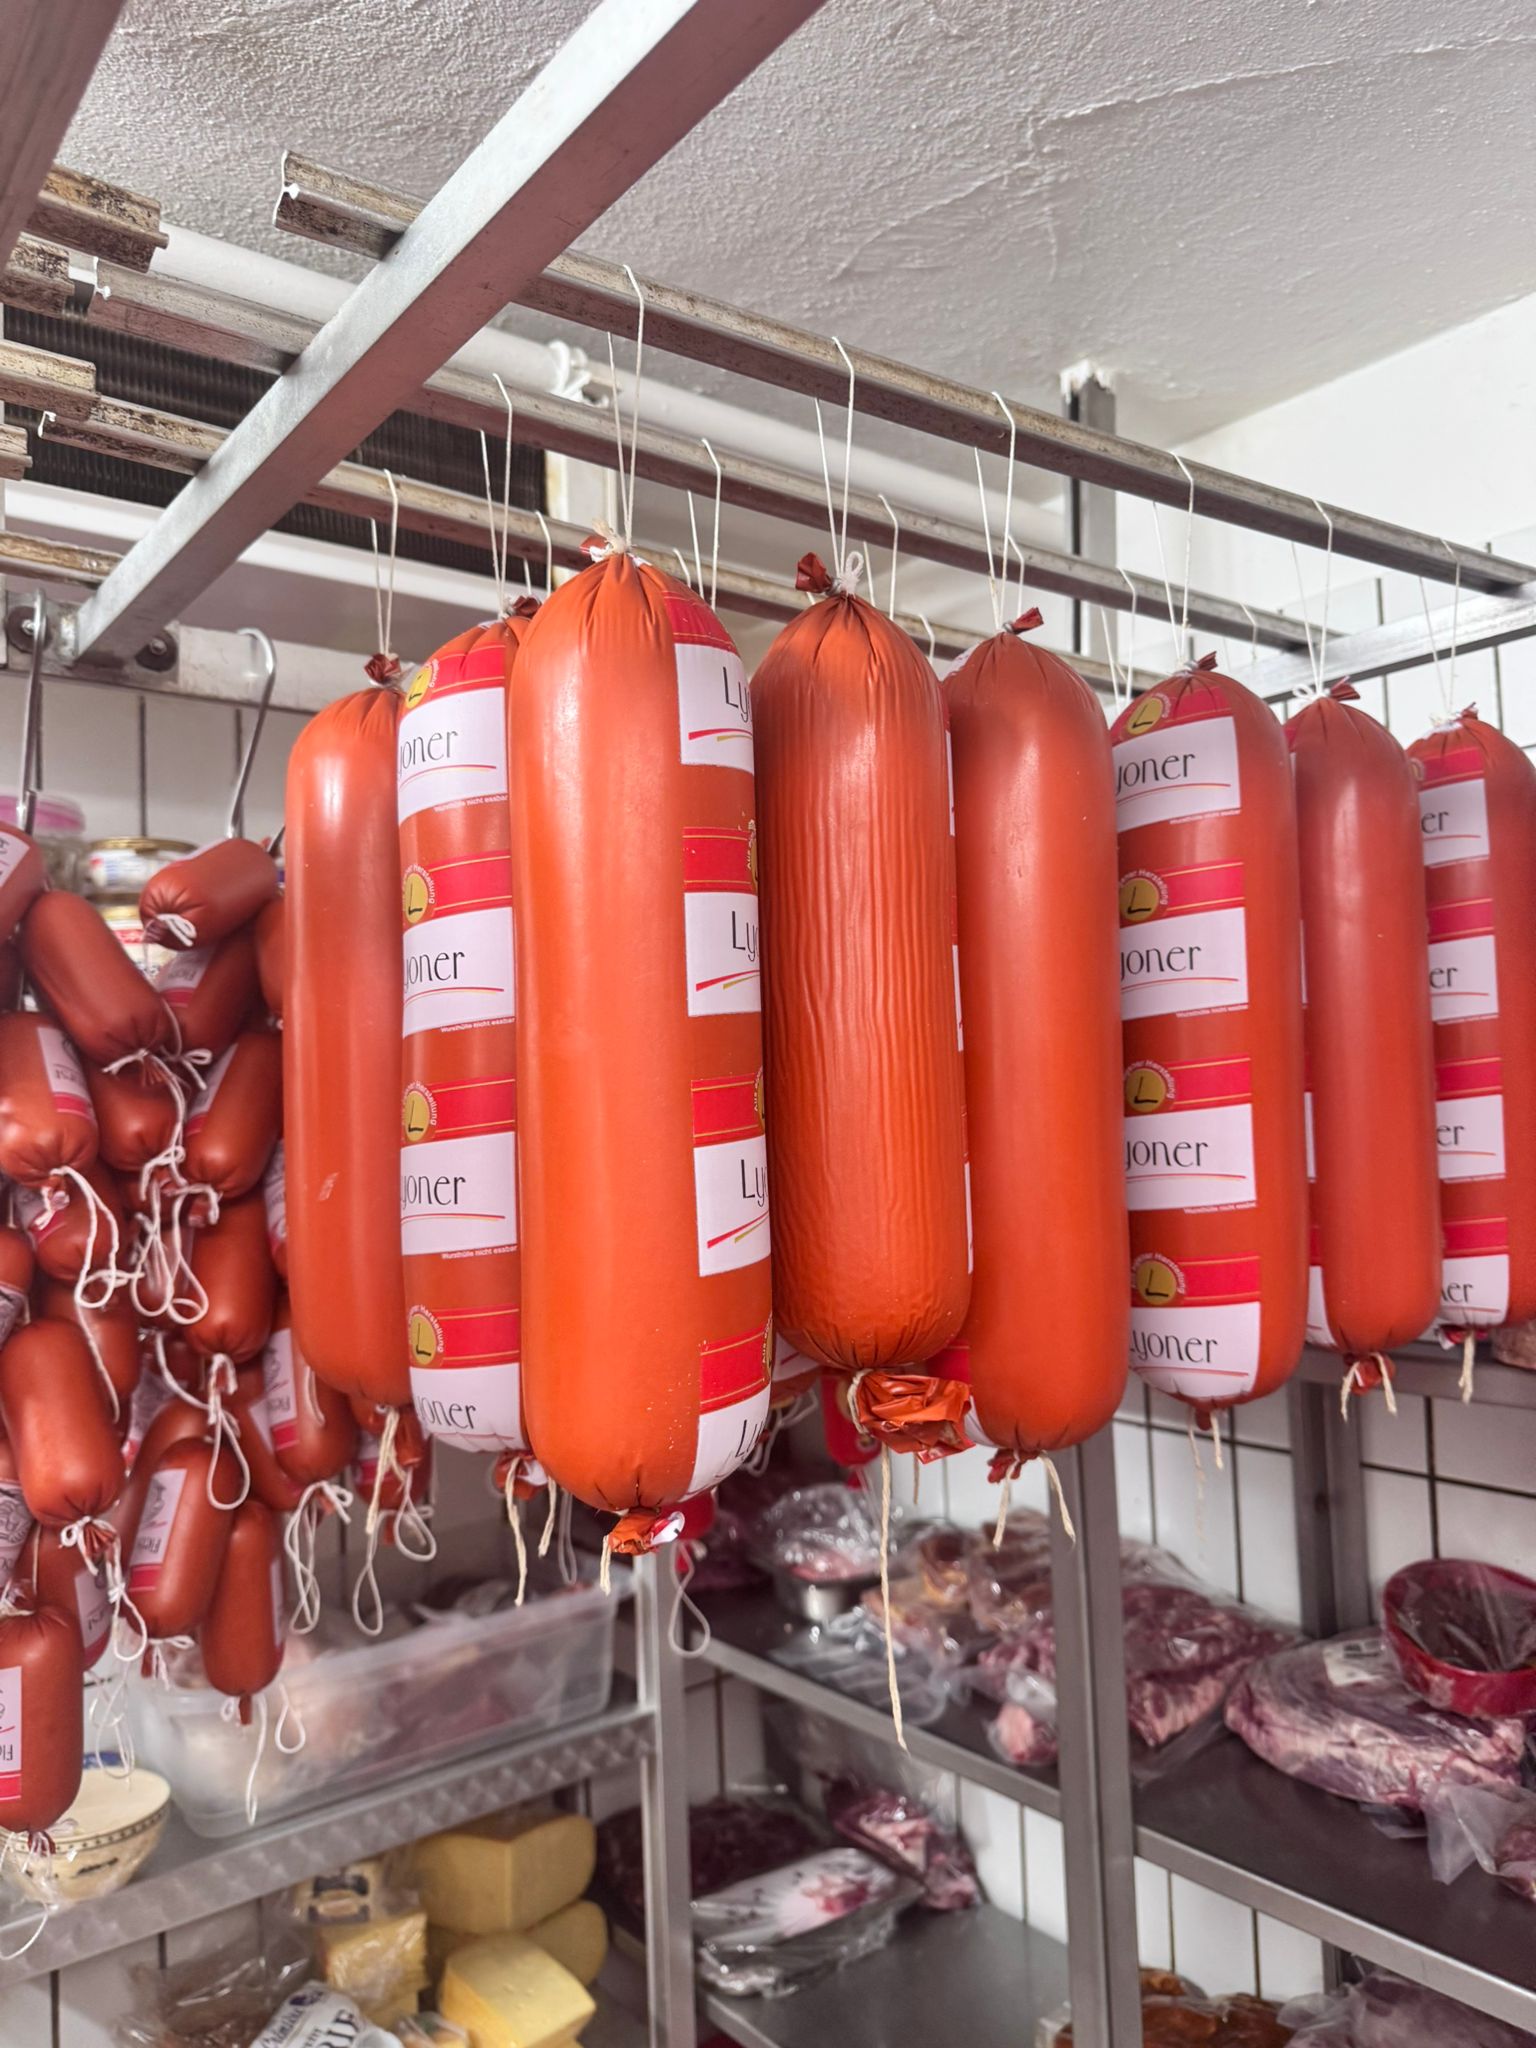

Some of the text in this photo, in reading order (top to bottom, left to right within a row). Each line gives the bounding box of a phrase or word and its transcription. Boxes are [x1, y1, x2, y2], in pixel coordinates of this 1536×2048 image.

[408, 882, 423, 916] L
[1126, 886, 1152, 915] L
[1133, 1076, 1159, 1104] L
[408, 1099, 424, 1132] L
[1144, 1269, 1169, 1298] L
[415, 1322, 432, 1357] L
[1131, 1329, 1218, 1363] yoner
